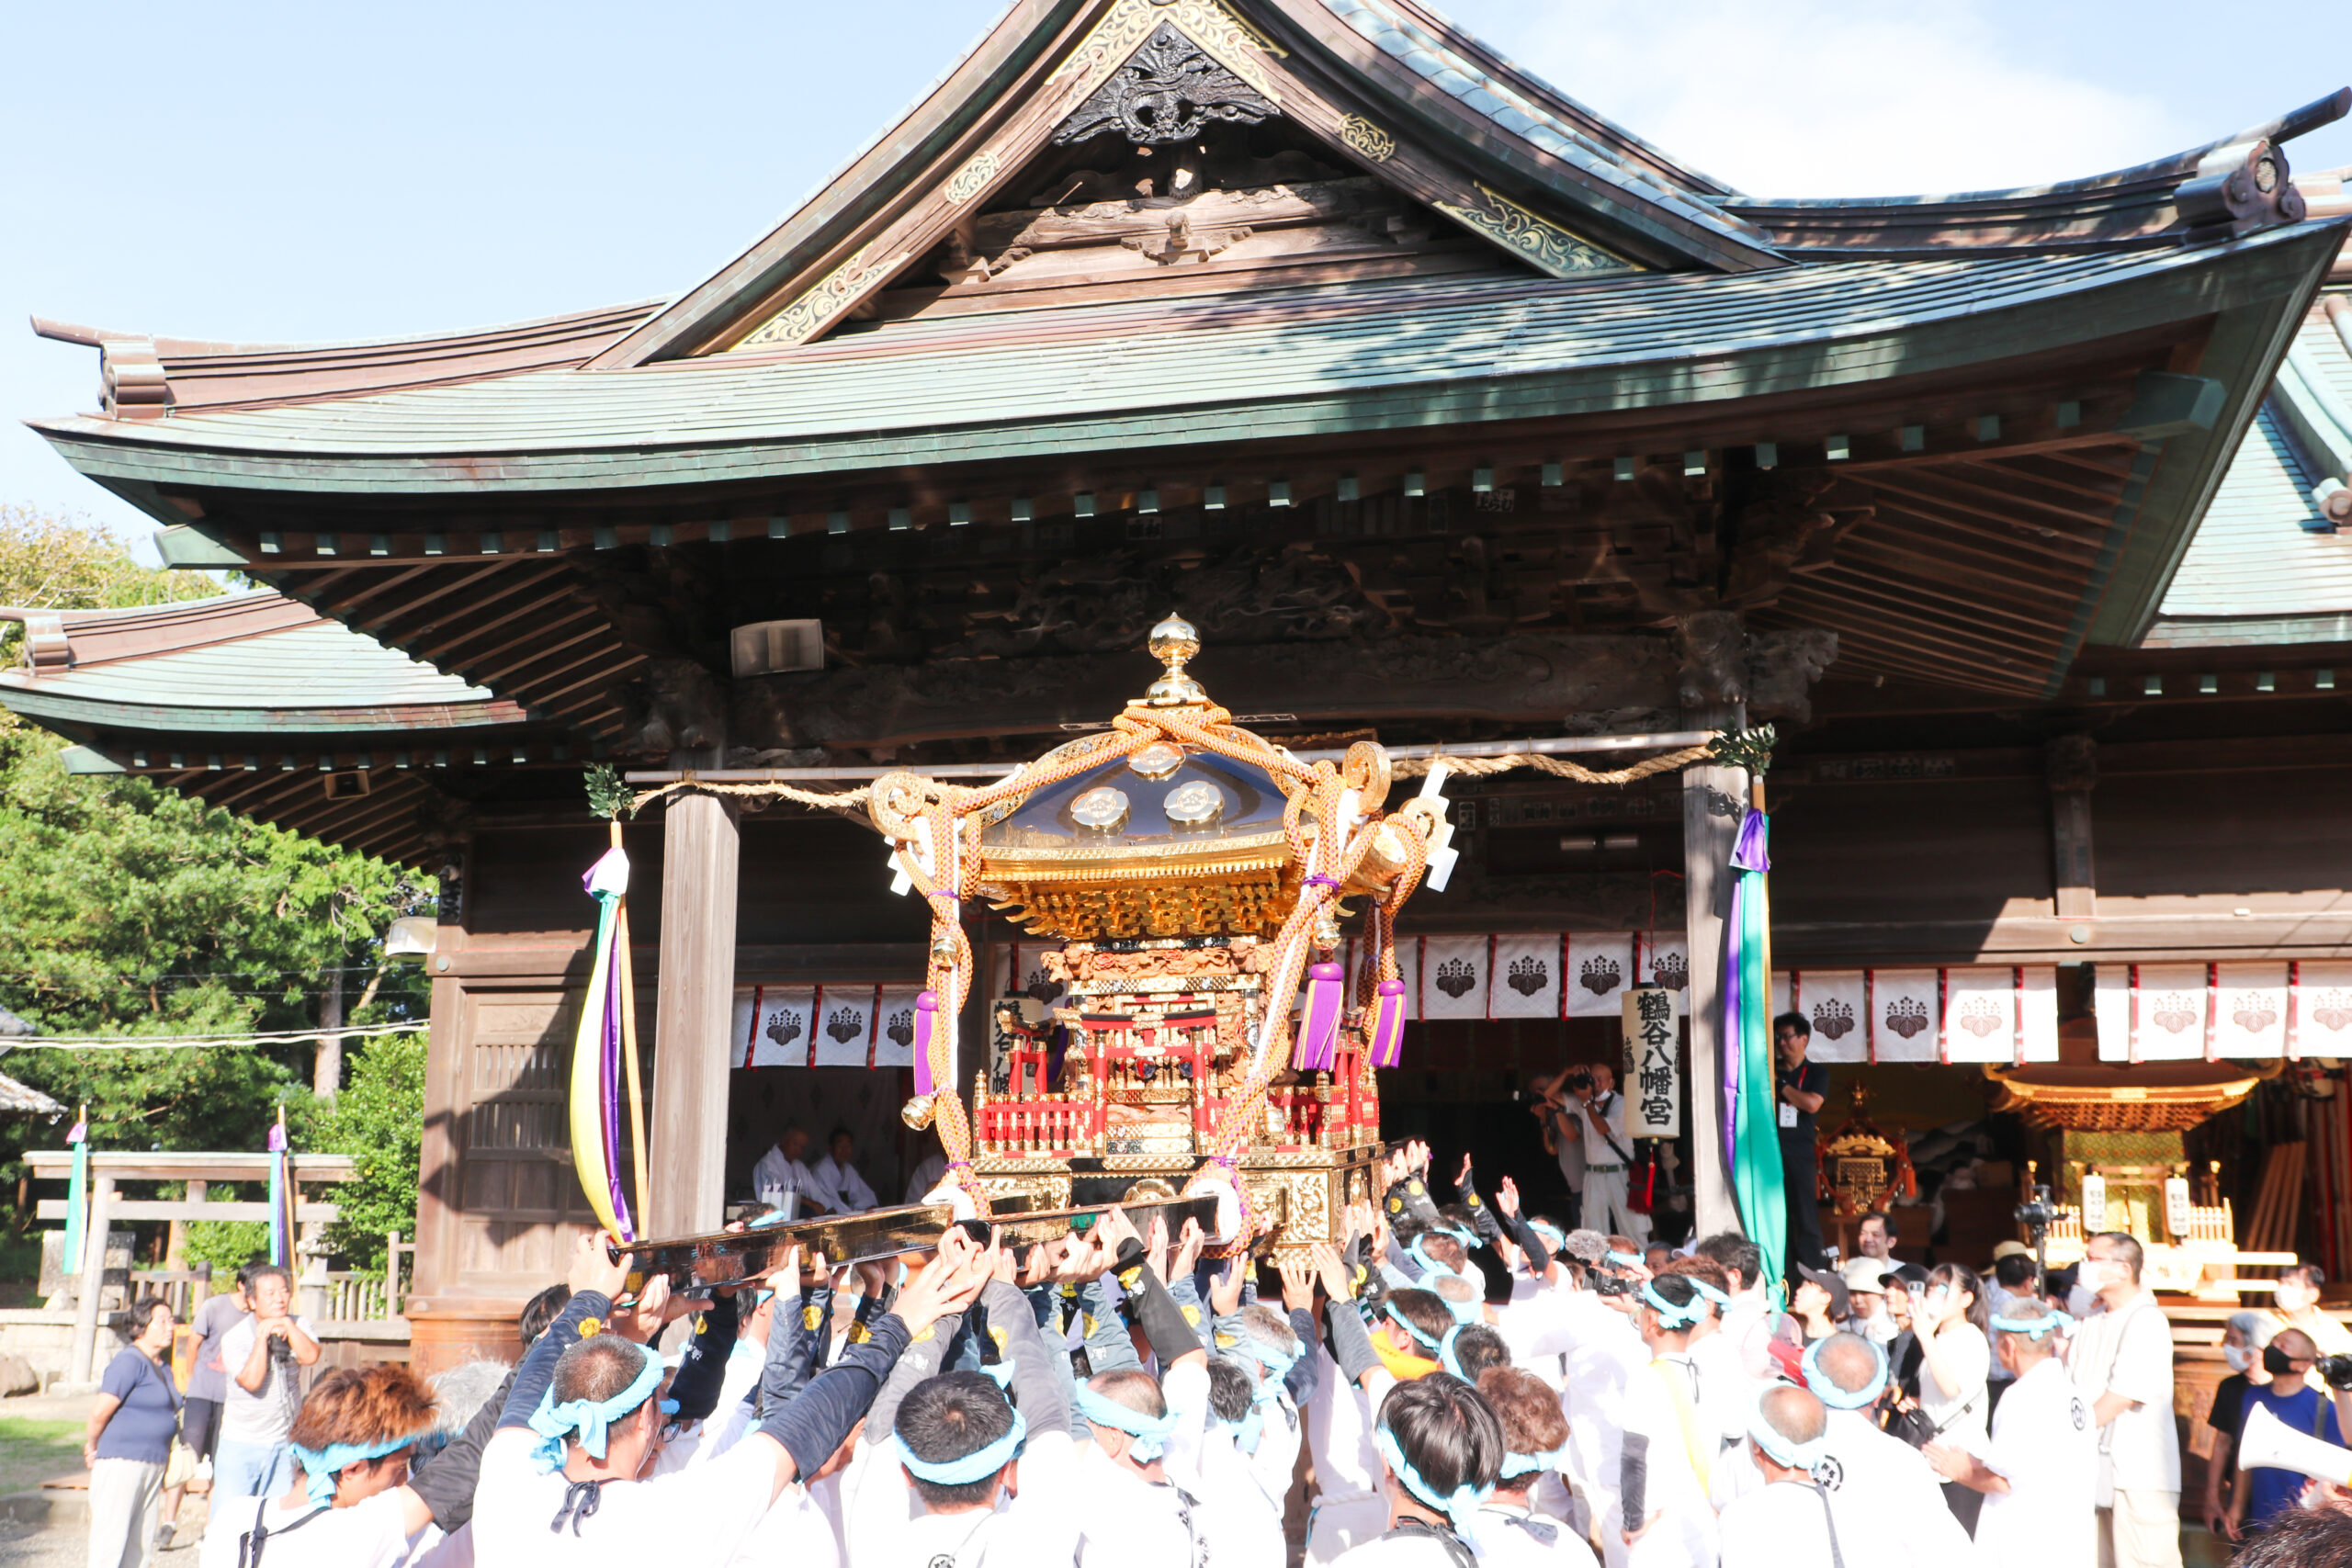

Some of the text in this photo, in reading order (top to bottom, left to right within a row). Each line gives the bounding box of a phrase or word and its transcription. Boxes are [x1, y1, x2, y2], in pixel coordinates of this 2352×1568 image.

[1637, 991, 1672, 1125] 鶴谷八幡宮
